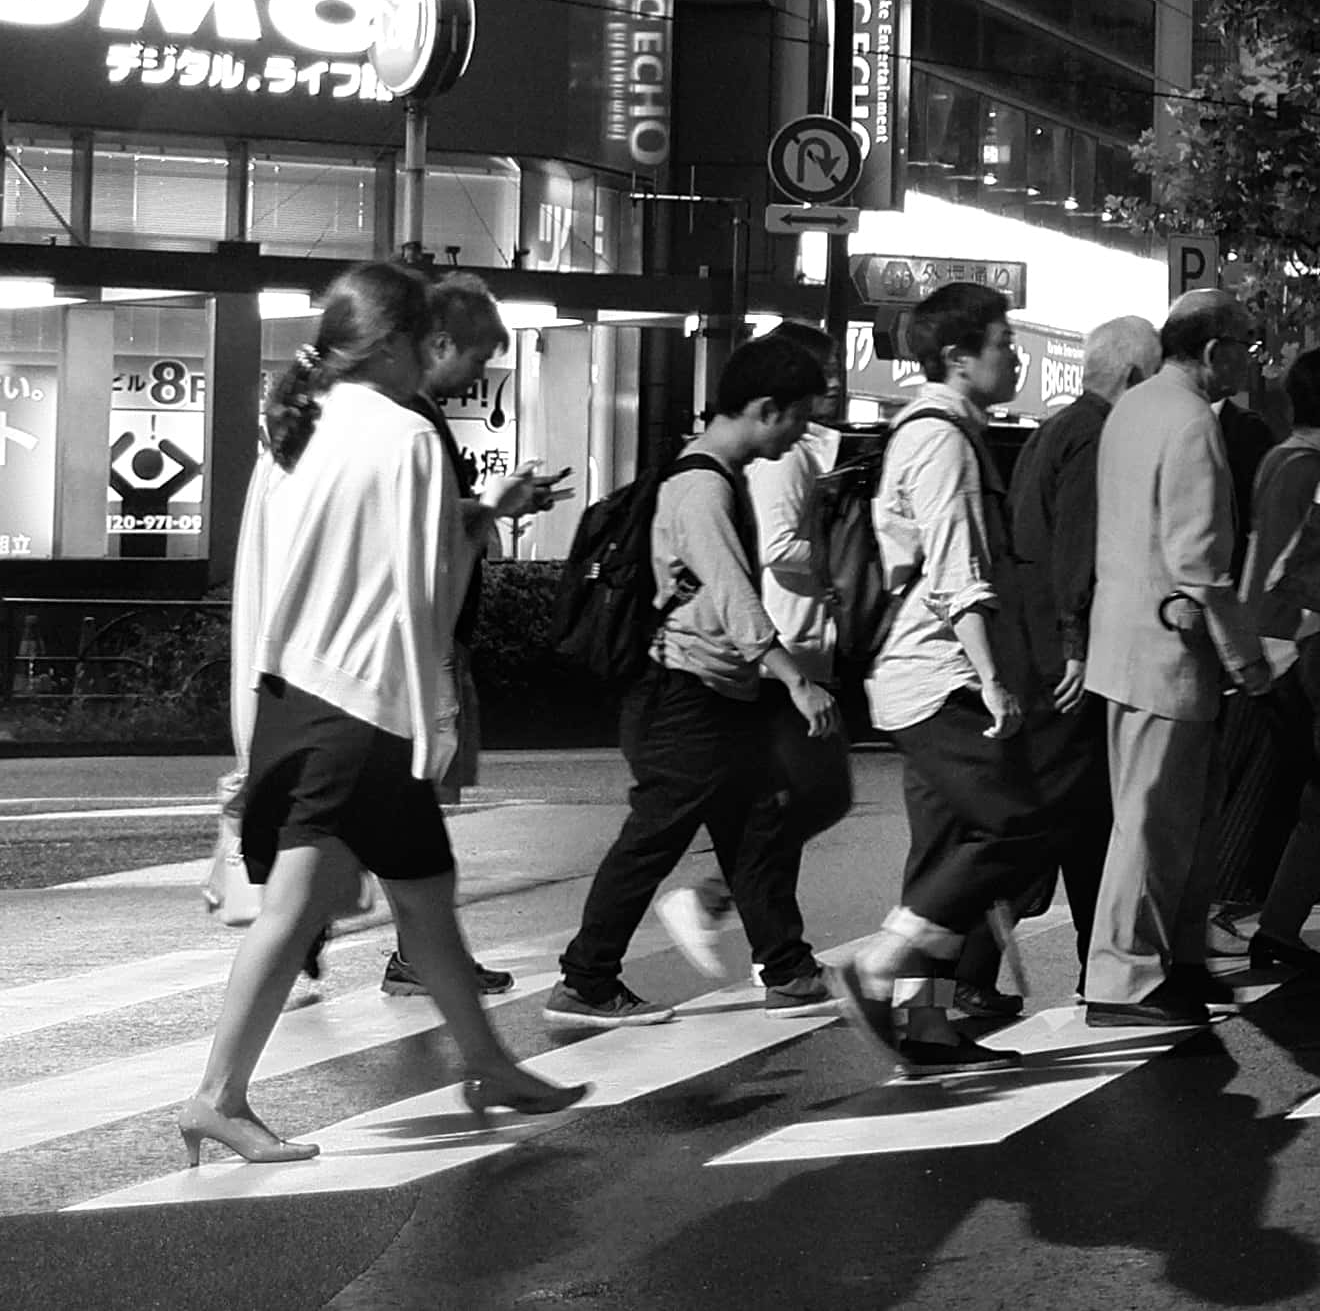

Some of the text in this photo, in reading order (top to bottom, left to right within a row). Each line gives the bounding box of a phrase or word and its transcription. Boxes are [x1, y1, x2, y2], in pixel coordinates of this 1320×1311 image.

[628, 31, 670, 165] ECHO
[875, 24, 892, 143] Entertainment
[1181, 246, 1206, 287] P
